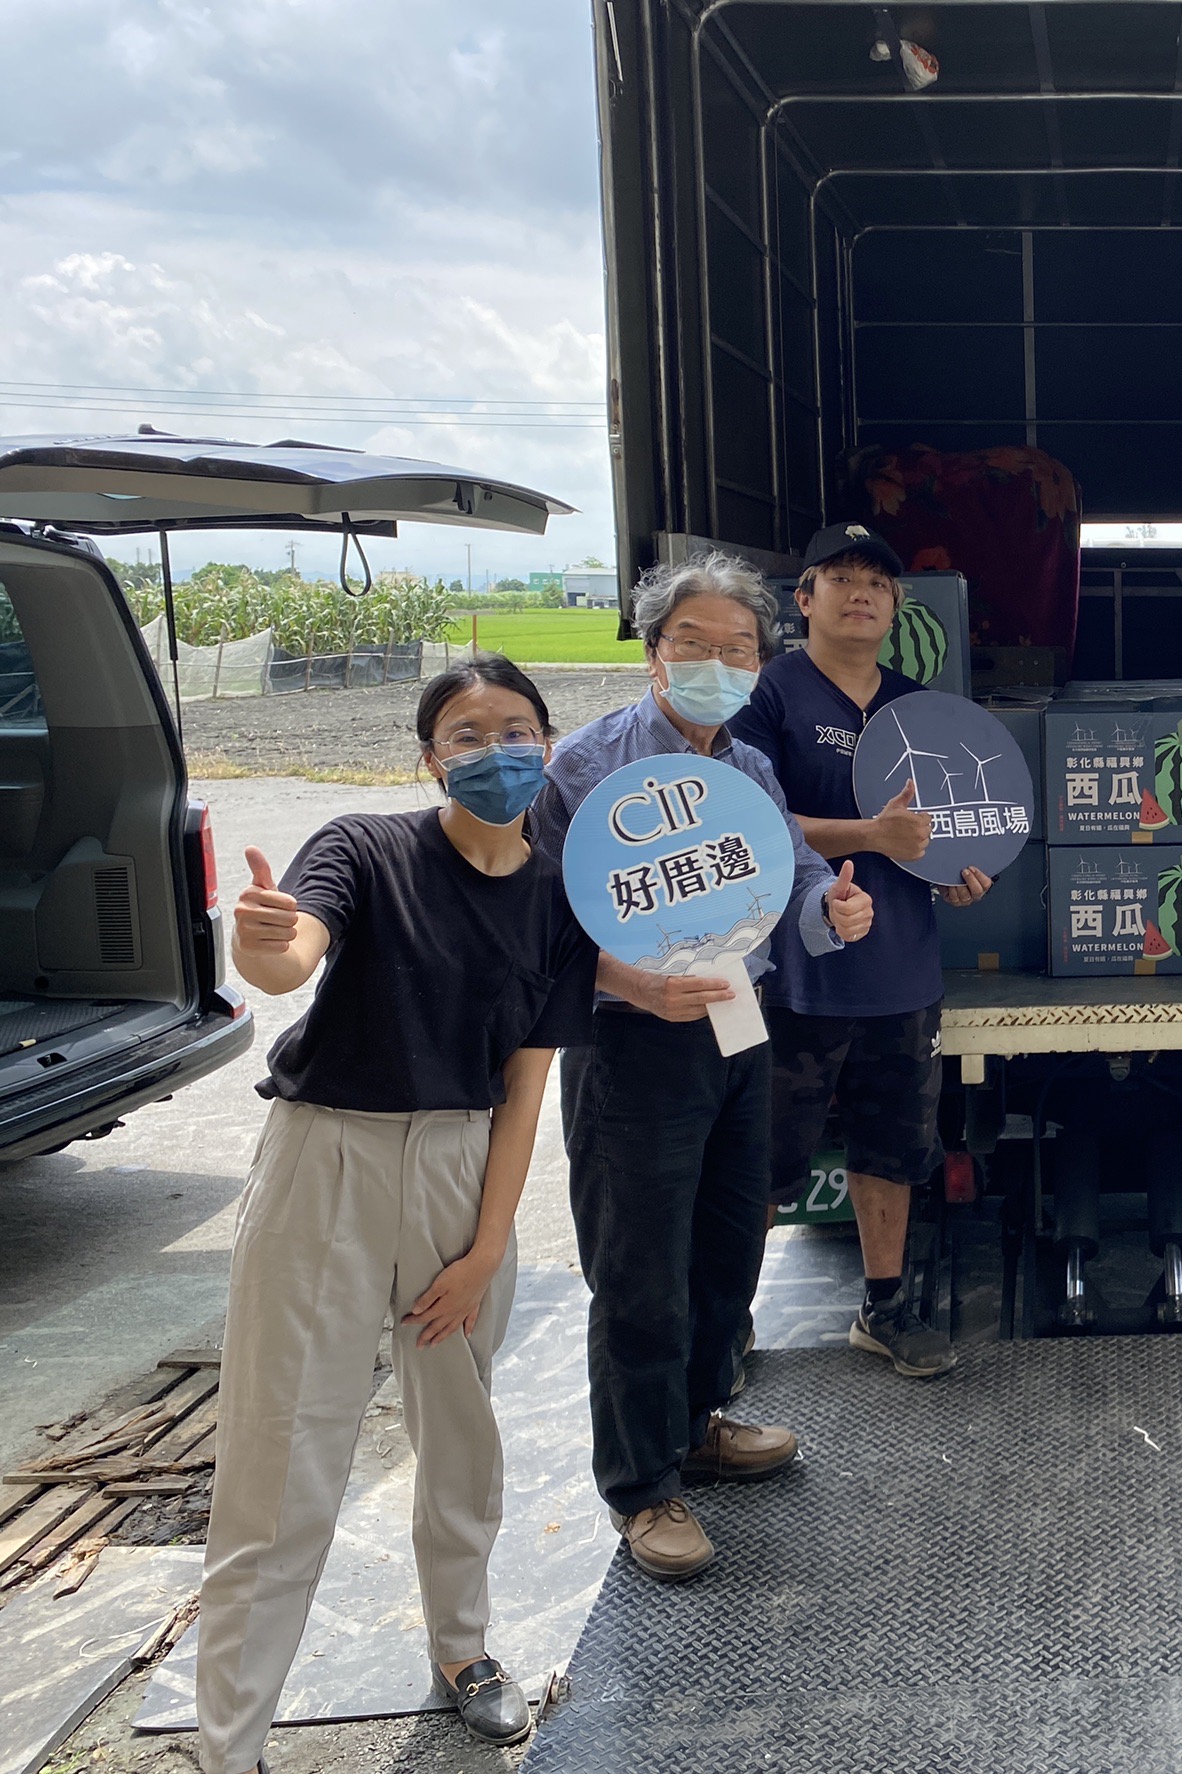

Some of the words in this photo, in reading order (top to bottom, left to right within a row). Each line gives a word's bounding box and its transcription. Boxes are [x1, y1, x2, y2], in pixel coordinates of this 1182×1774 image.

[1066, 756, 1144, 769] 彰化縣福興鄉
[1065, 771, 1143, 806] 西瓜
[872, 806, 1030, 840] 西島風場
[1068, 811, 1140, 821] WATERMELON
[610, 836, 757, 920] 好厝邊
[1071, 889, 1148, 901] 彰化縣福興鄉
[1069, 902, 1147, 938] 西瓜
[1072, 943, 1144, 952] WATERMELON
